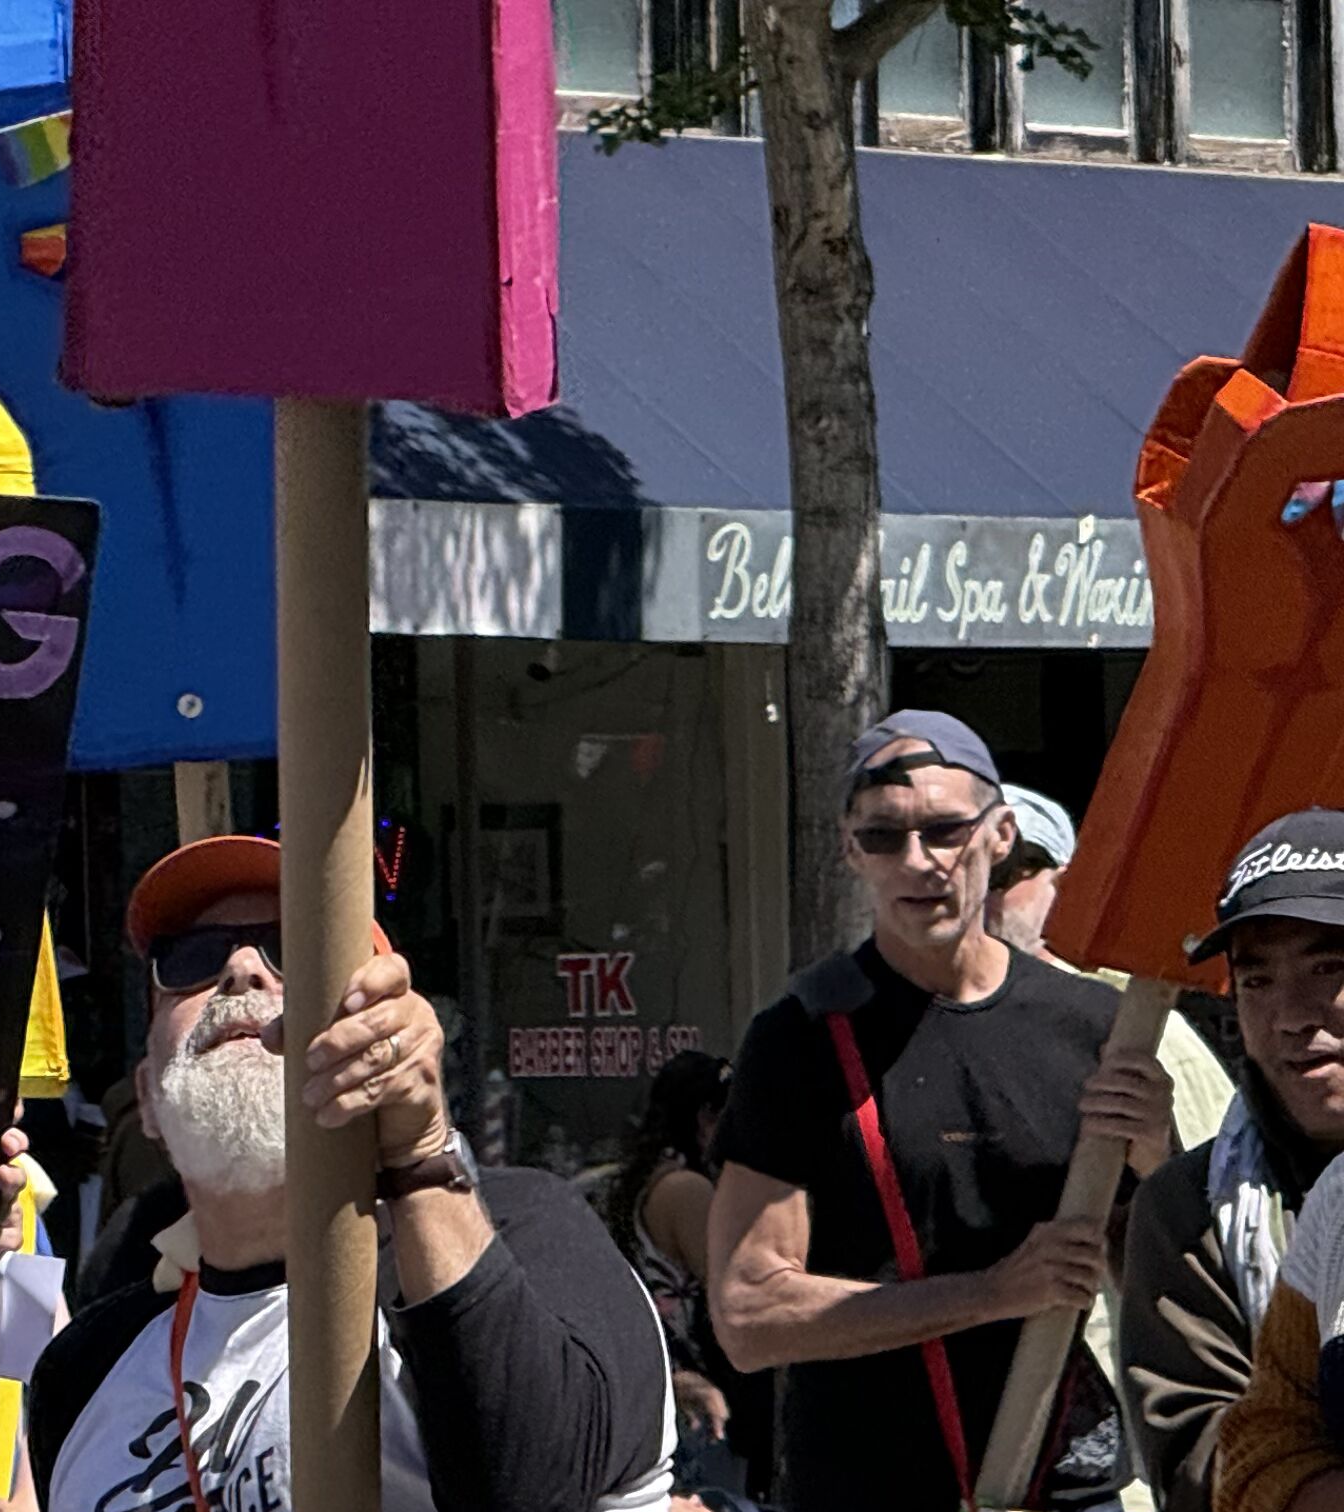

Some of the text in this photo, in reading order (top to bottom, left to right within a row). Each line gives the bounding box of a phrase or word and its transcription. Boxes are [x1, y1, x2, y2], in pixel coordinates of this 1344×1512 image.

[936, 540, 1006, 641] Spa
[1018, 532, 1052, 625] &
[556, 952, 637, 1018] TK
[509, 1027, 588, 1078] BARBER
[590, 1027, 644, 1078] SHOP
